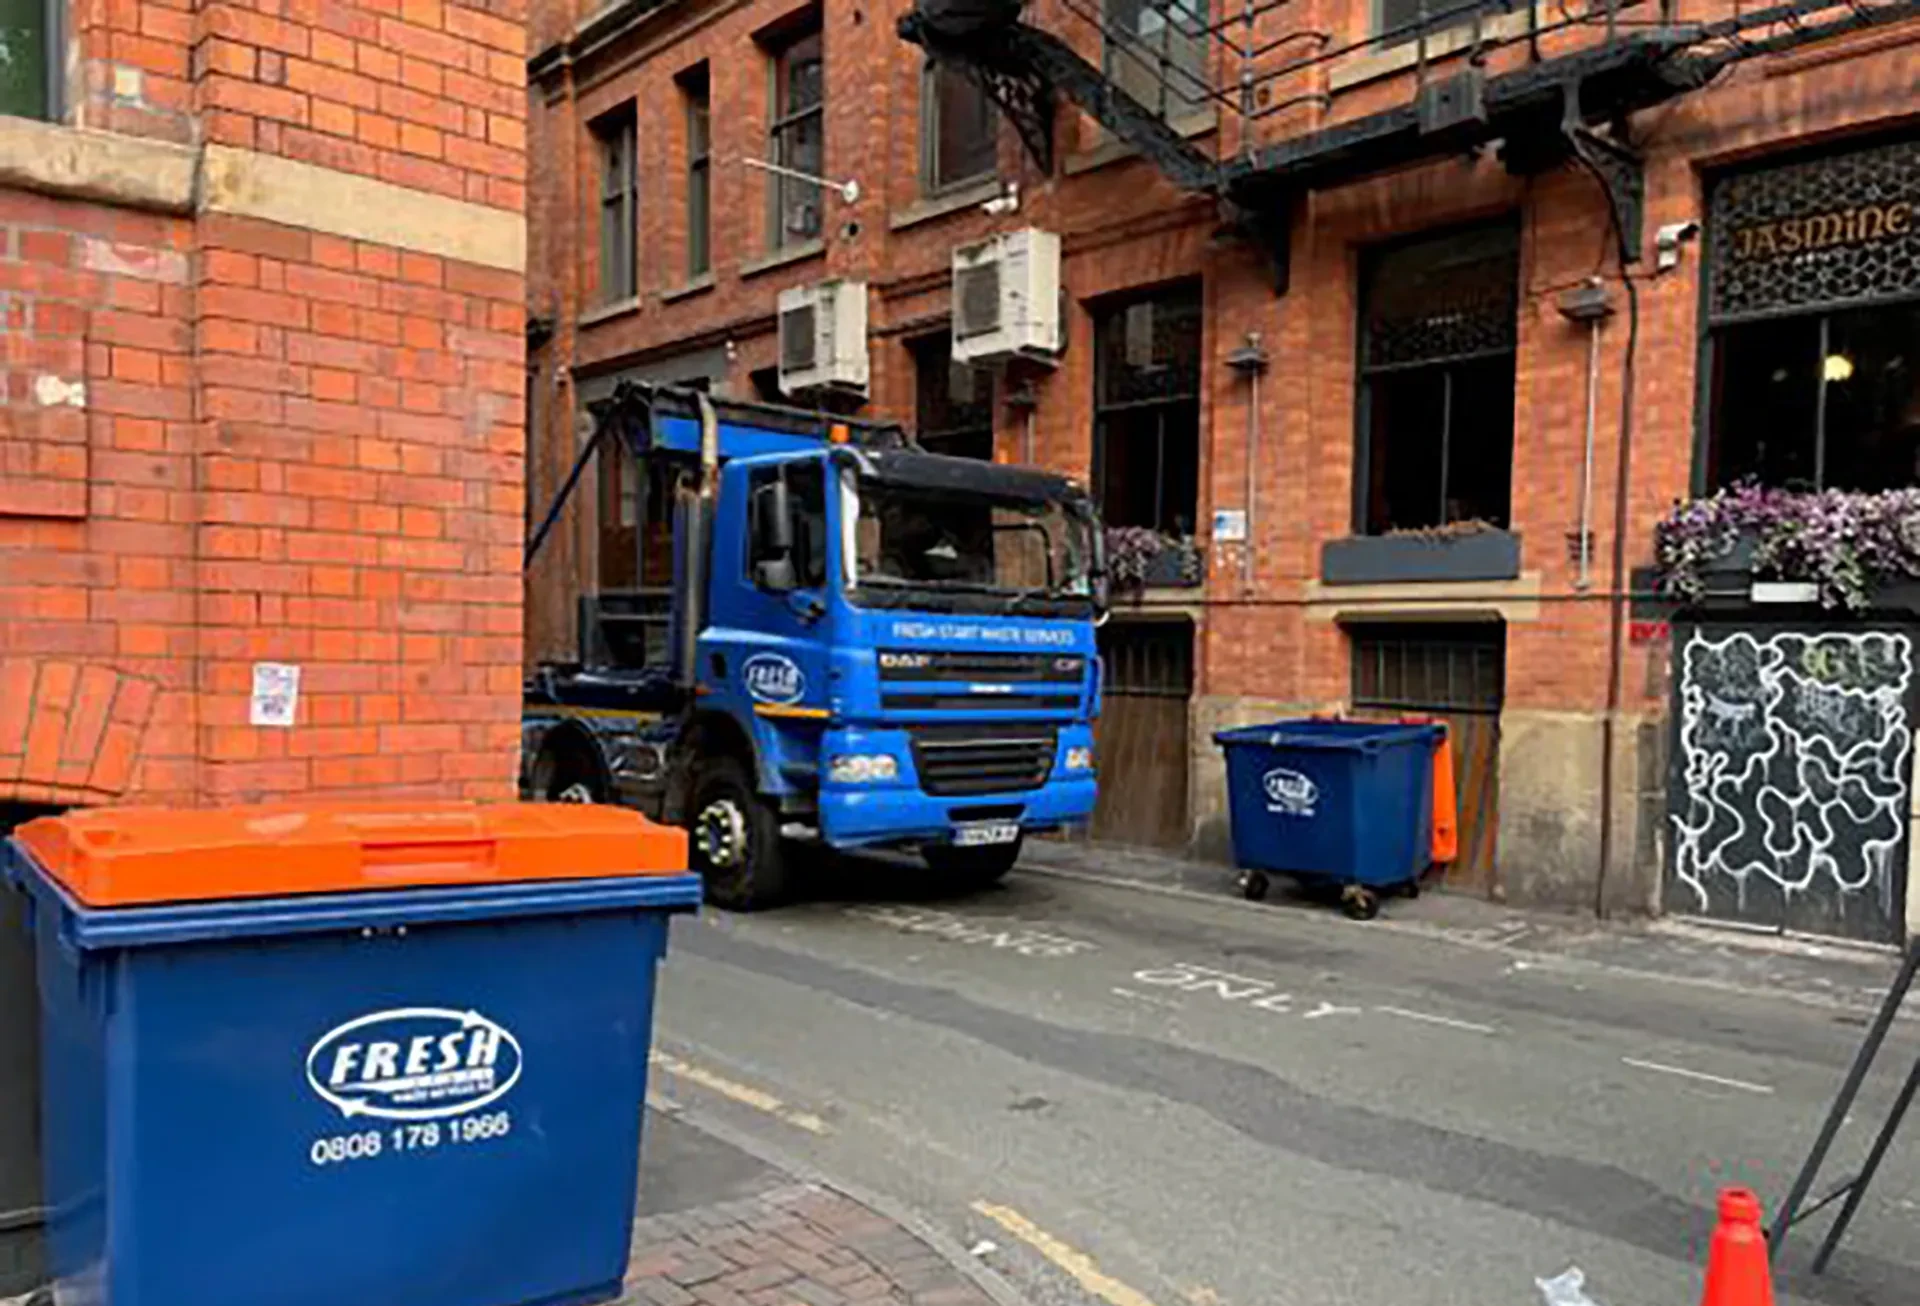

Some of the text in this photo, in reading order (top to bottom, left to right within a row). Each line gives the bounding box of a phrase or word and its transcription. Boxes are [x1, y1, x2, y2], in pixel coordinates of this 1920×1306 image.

[880, 653, 930, 668] DAF
[1132, 969, 1363, 1019] ONLY
[329, 1025, 501, 1085] FRESH
[310, 1130, 383, 1166] 0808
[391, 1121, 440, 1151] 178
